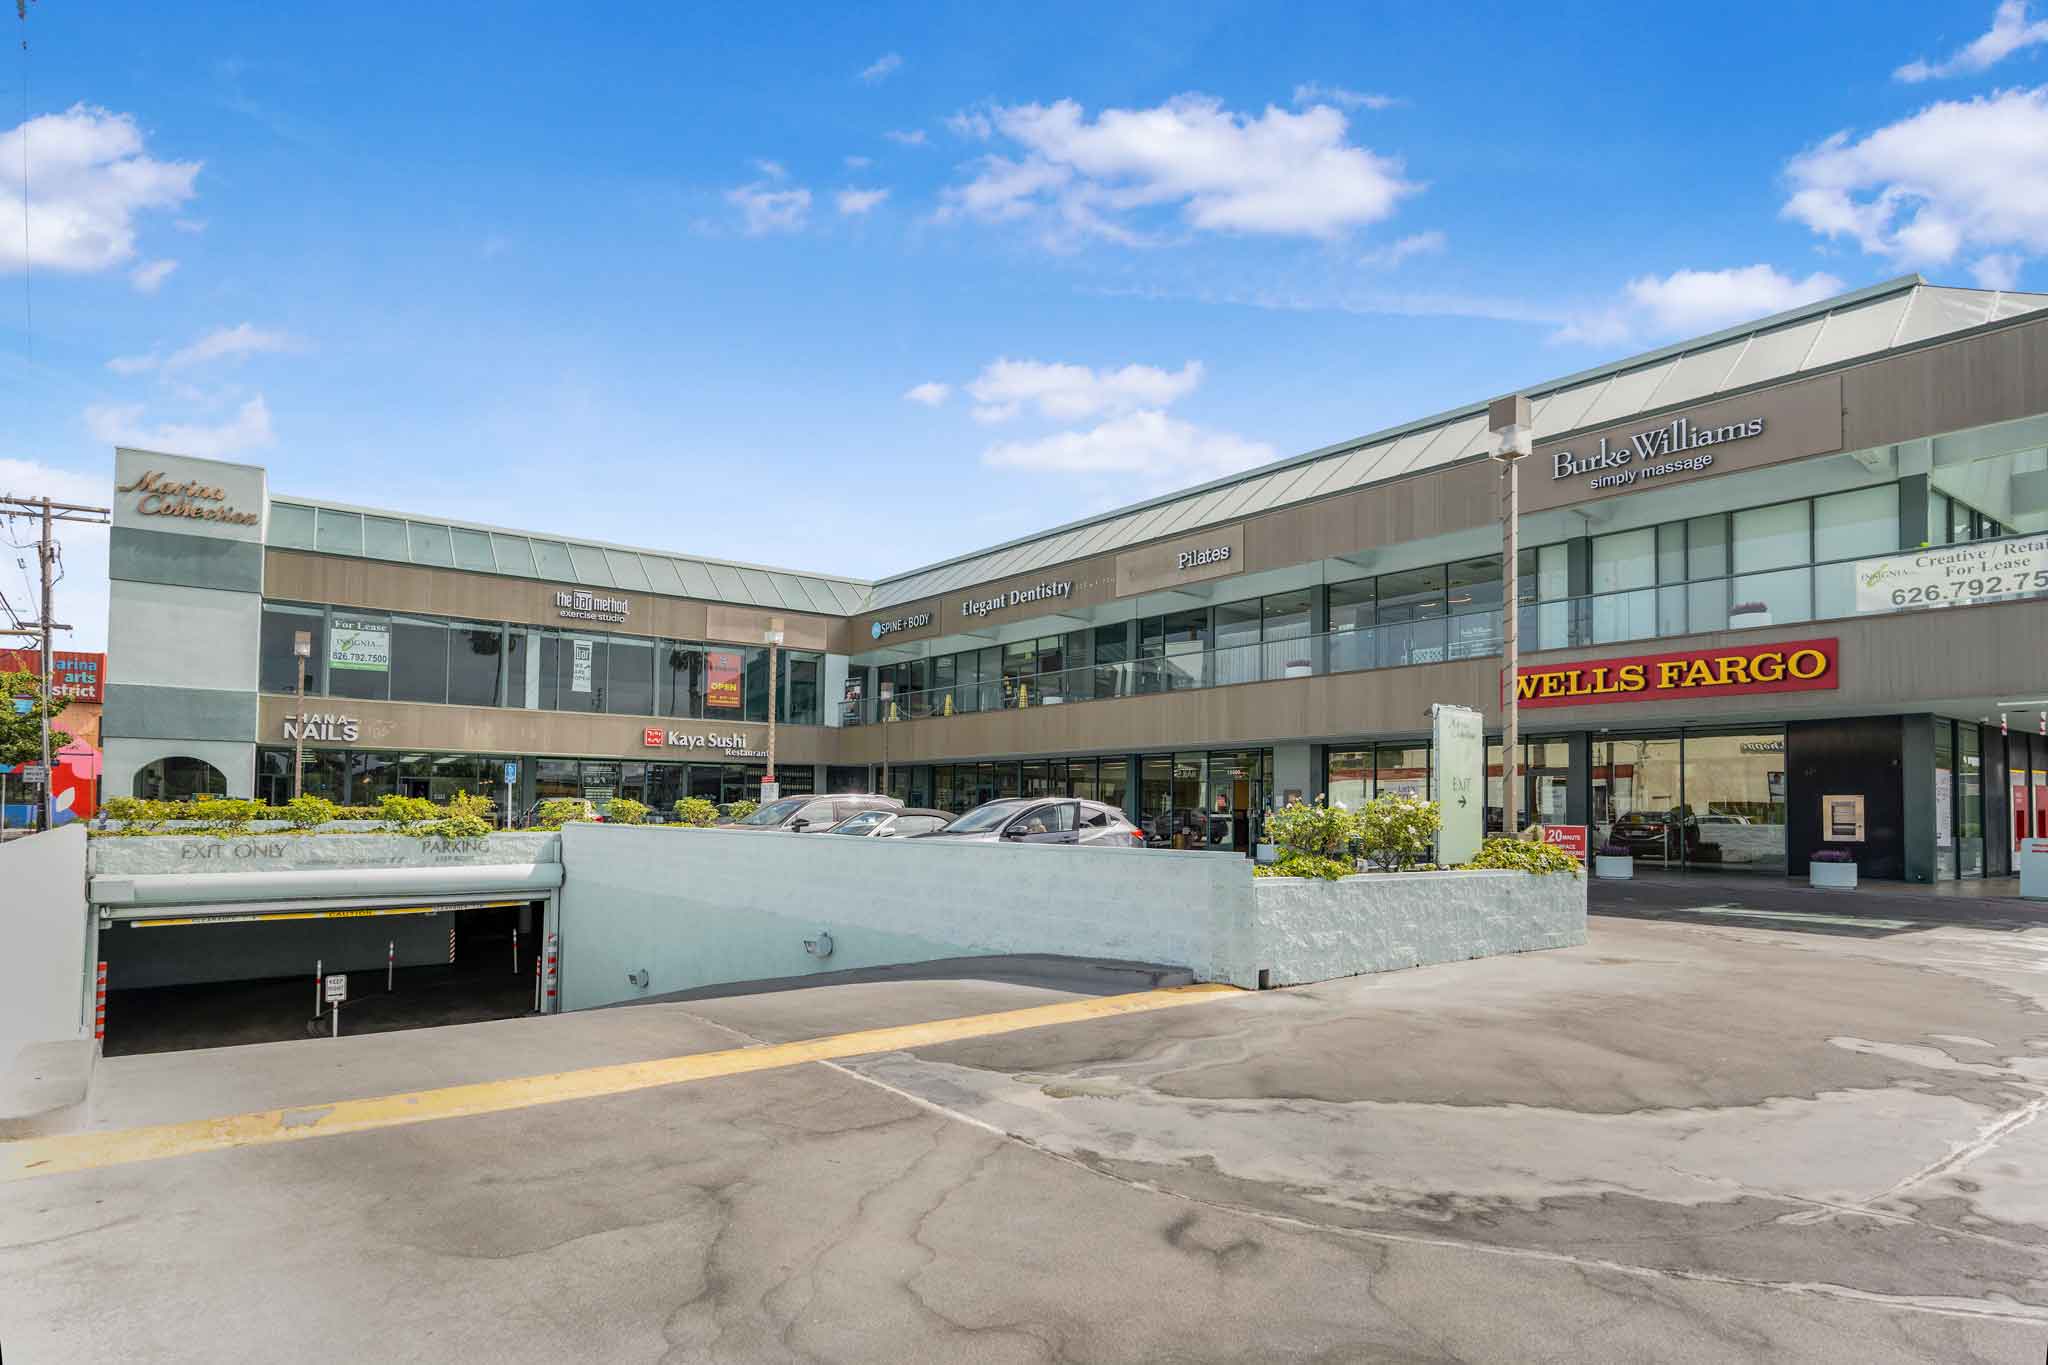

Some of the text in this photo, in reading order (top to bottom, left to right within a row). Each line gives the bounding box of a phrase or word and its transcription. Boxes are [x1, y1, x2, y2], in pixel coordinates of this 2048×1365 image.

[1552, 417, 1764, 480] Burke Williams
[1590, 453, 1713, 489] simply massage
[117, 470, 225, 501] Marina
[1177, 545, 1231, 569] Pilates
[1915, 549, 1987, 568] Creative
[1945, 558, 2032, 578] For Lease
[1891, 569, 2048, 606] 626.792.75
[556, 591, 572, 608] the
[962, 594, 1006, 617] Elegant
[1010, 581, 1073, 605] Dentistry
[335, 620, 387, 632] For Lease
[560, 610, 625, 623] exercise studio
[881, 619, 902, 634] SPINE
[908, 612, 930, 629] BODY
[53, 657, 97, 671] arina
[64, 671, 97, 684] arts
[1516, 649, 1827, 700] WELLS FARGO
[51, 684, 96, 697] strict
[711, 682, 737, 691] OPEN
[283, 722, 359, 742] NAILS
[668, 730, 705, 750] Kaya
[708, 732, 747, 749] Sushi
[725, 748, 769, 757] Restaurant
[1548, 829, 1563, 842] 20
[181, 841, 288, 859] EXIT ONLY
[422, 839, 490, 854] PARKING
